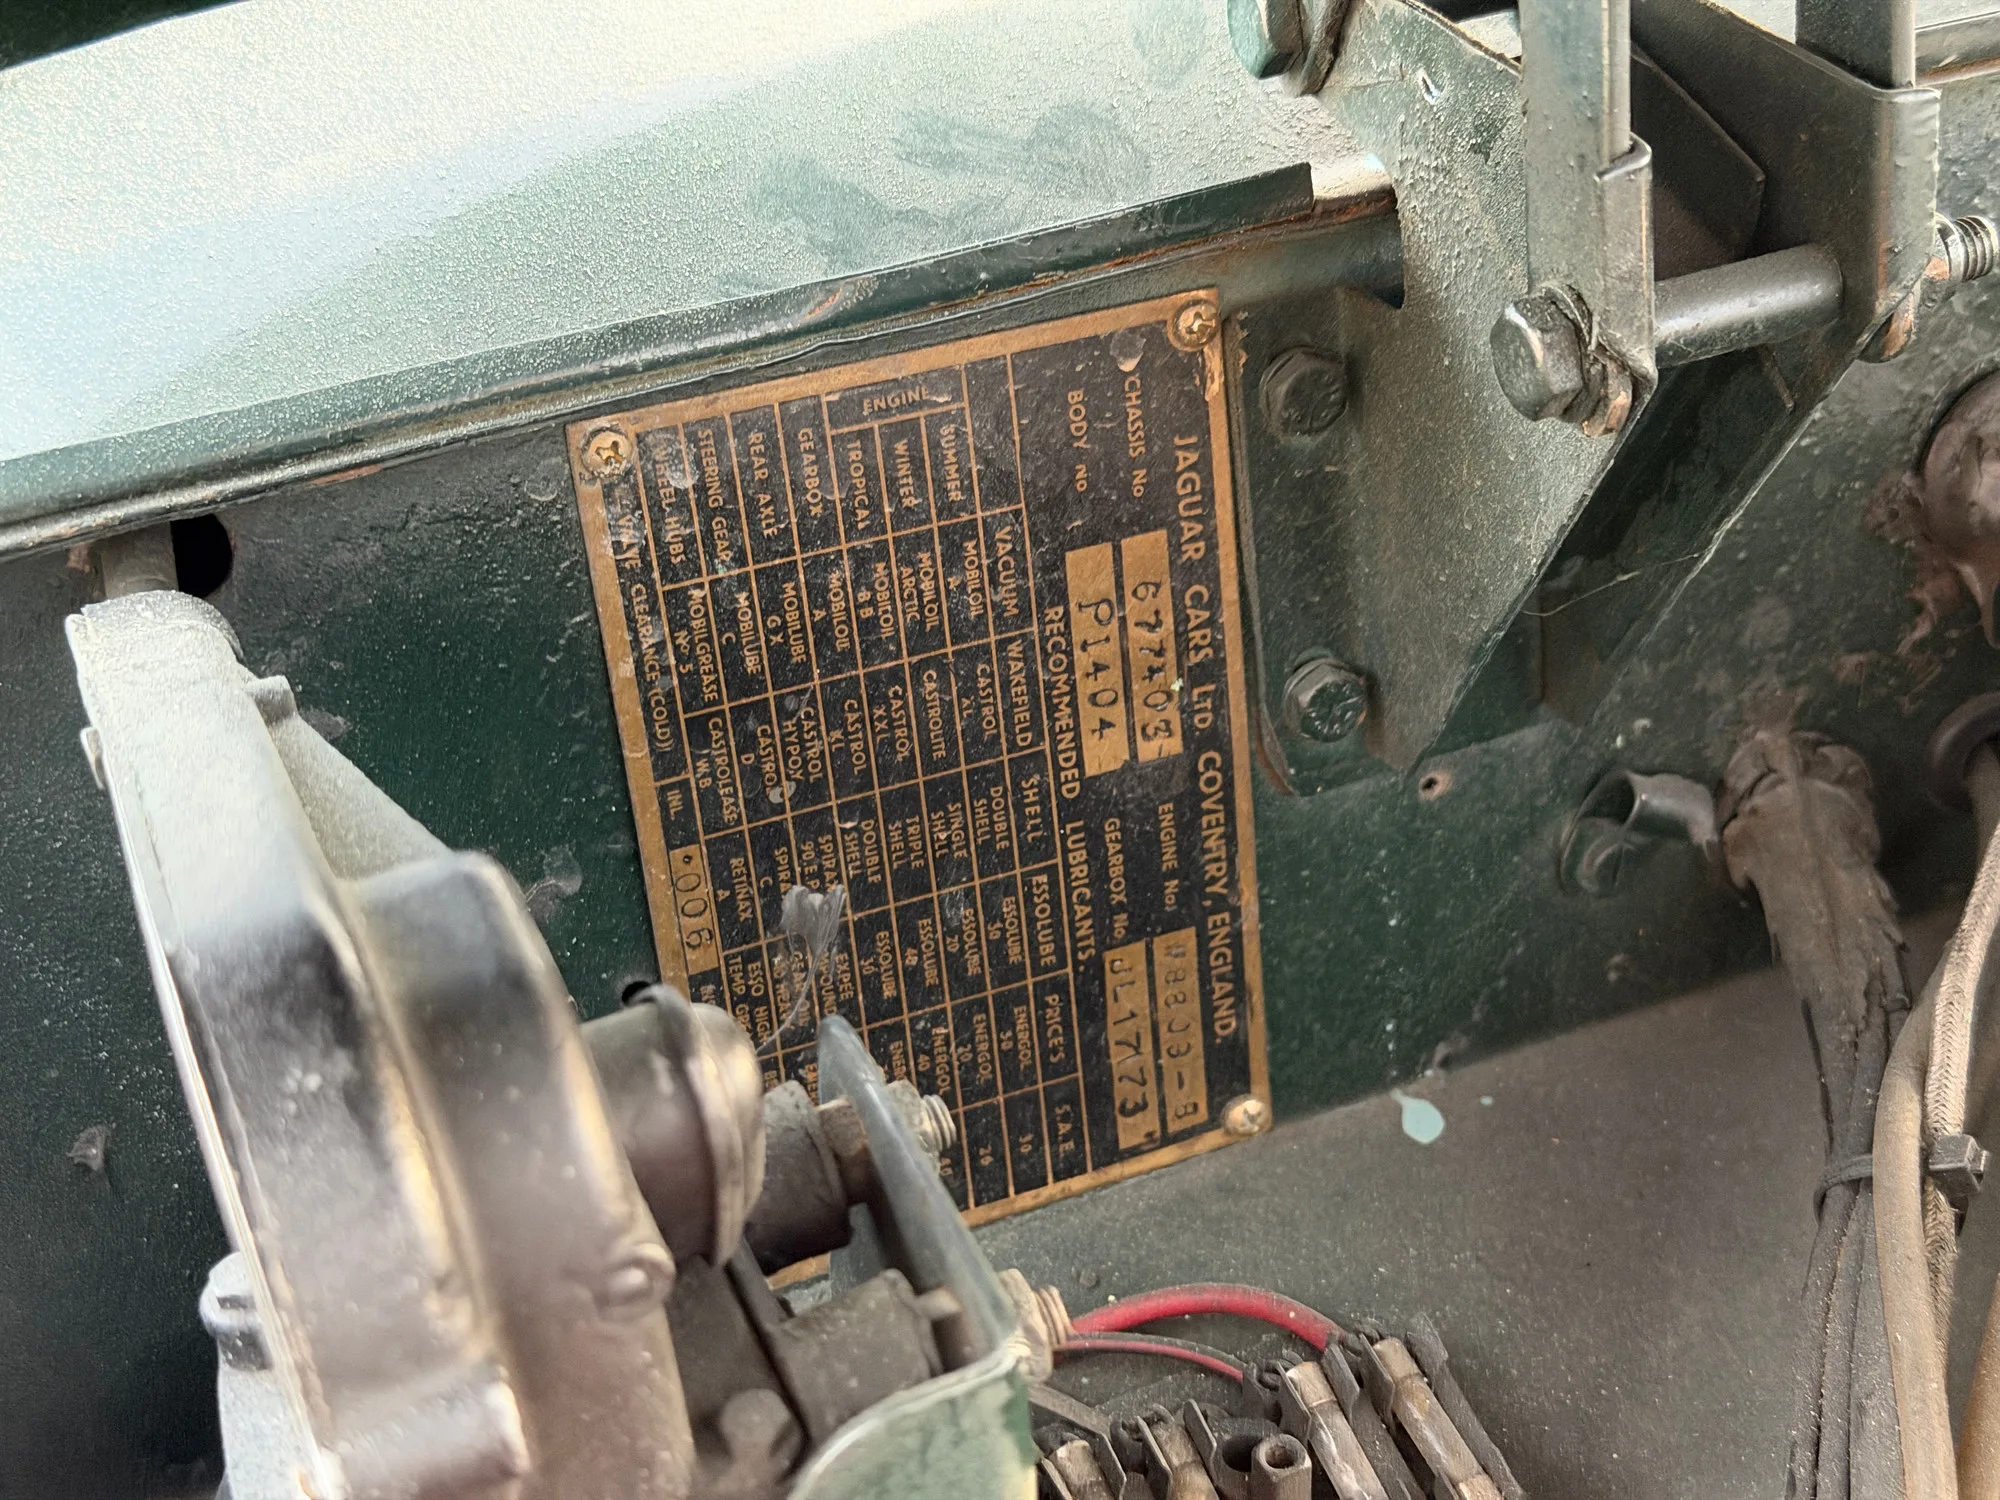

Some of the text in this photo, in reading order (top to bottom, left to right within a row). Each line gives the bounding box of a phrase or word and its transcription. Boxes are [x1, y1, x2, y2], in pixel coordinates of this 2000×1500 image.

[860, 385, 930, 415] ENGINE
[1065, 387, 1089, 452] BODY
[1122, 374, 1147, 458] CHASSIS
[693, 428, 733, 563] STEERING GEAR
[746, 431, 778, 538] REAR AXLE
[794, 426, 826, 518] GEARBOX
[843, 439, 874, 530] TROPICAL
[891, 438, 917, 509] WINTER
[937, 423, 963, 503] SUMMER
[1171, 431, 1206, 563] JAGUAR
[612, 514, 642, 570] VALVE
[661, 515, 687, 565] HUBS
[992, 526, 1020, 618] VACUUM
[811, 607, 827, 622] A
[823, 573, 852, 652] MOBILOIL
[868, 561, 897, 641] MOBILOIL
[898, 564, 920, 624] ARCTIC
[913, 551, 941, 633] MOBILOIL
[960, 539, 986, 620] MOBILOIL
[624, 582, 664, 682] CLEARANCE
[681, 587, 725, 703] MOBILGREASE
[719, 631, 735, 646] C
[731, 591, 763, 676] MOBILUBE
[776, 581, 808, 665] MOBILUBE
[1183, 582, 1211, 665] CARS
[884, 683, 912, 762] CASTROL
[920, 668, 948, 760] CASTROLITE
[973, 661, 998, 742] CASTROL
[1003, 639, 1034, 748] WAKEFIELD
[701, 716, 742, 825] CASTROLEASE
[739, 751, 755, 766] D
[795, 705, 826, 784] CASTROL
[840, 697, 868, 776] CASTROL
[971, 796, 992, 845] SHELL
[987, 784, 1010, 851] DOUBLE
[1019, 775, 1045, 843] SHELL
[1039, 605, 1099, 973] RECOMMENDED LUBRICANTS.
[842, 831, 864, 879] SHELL
[857, 818, 884, 885] DOUBLE
[885, 820, 907, 870] SHELL
[903, 814, 926, 870] TRIPLE
[928, 809, 949, 858] SHELL
[945, 801, 968, 861] SINGLE
[1101, 815, 1127, 908] GEARBOX
[1155, 801, 1179, 872] ENGINE
[1190, 747, 1231, 907] COVENTRY,
[715, 886, 732, 901] A
[725, 856, 756, 922] RETINAX
[757, 875, 773, 889] C
[771, 845, 795, 895] SPIRA
[914, 916, 941, 988] ESSOLUBE
[943, 933, 960, 954] 20
[957, 908, 982, 977] ESSOLUBE
[999, 894, 1023, 965] ESSOLUBE
[1028, 872, 1058, 968] ESSOLUBE
[744, 960, 767, 998] ESSO
[831, 952, 855, 1001] EXPEE
[872, 929, 899, 1000] ESSOLUBE
[1205, 910, 1239, 1045] ENGLAND.
[915, 1051, 931, 1072] 40
[928, 1024, 956, 1096] ENERGOL
[956, 1043, 973, 1064] 20
[969, 1012, 995, 1084] ENERGOL
[1011, 1003, 1034, 1072] ENERGOL
[1040, 991, 1067, 1065] PRICE'S
